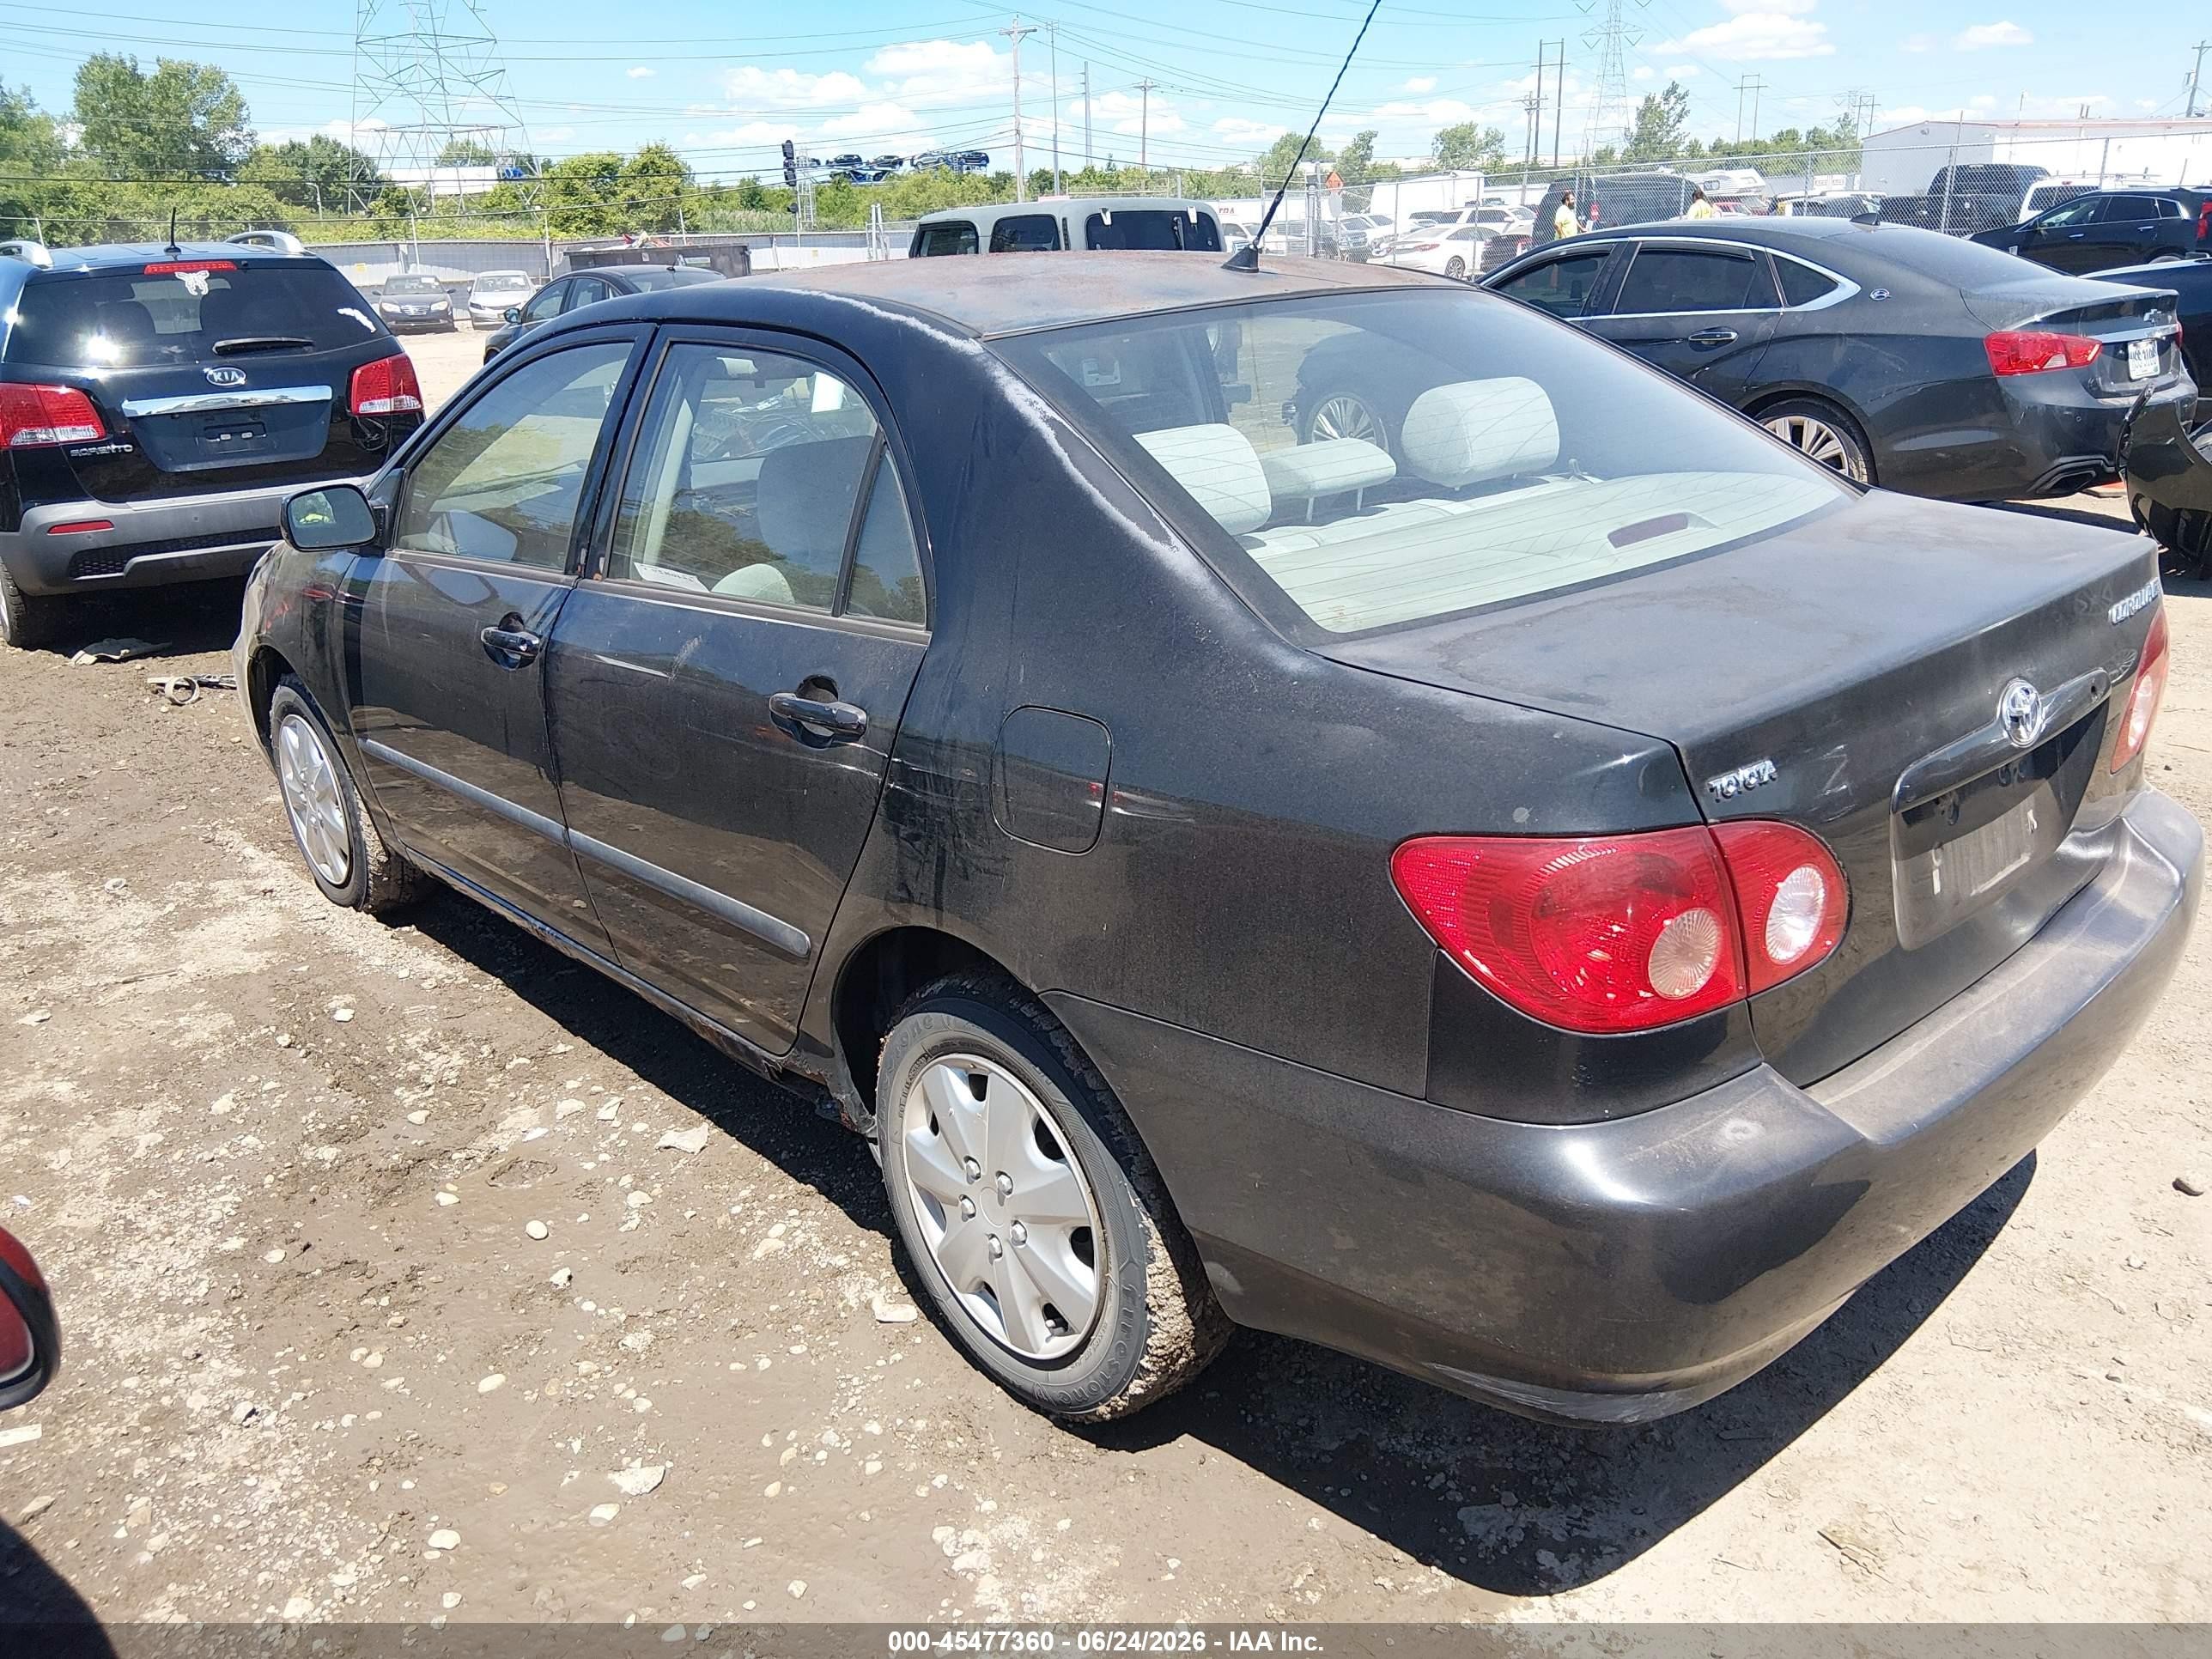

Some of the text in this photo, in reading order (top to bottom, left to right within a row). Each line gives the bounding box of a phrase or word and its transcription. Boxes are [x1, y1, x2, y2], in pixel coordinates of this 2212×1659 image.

[213, 370, 240, 382] KIA
[70, 444, 133, 457] SORENTO
[1706, 759, 1777, 802] TOYOTA
